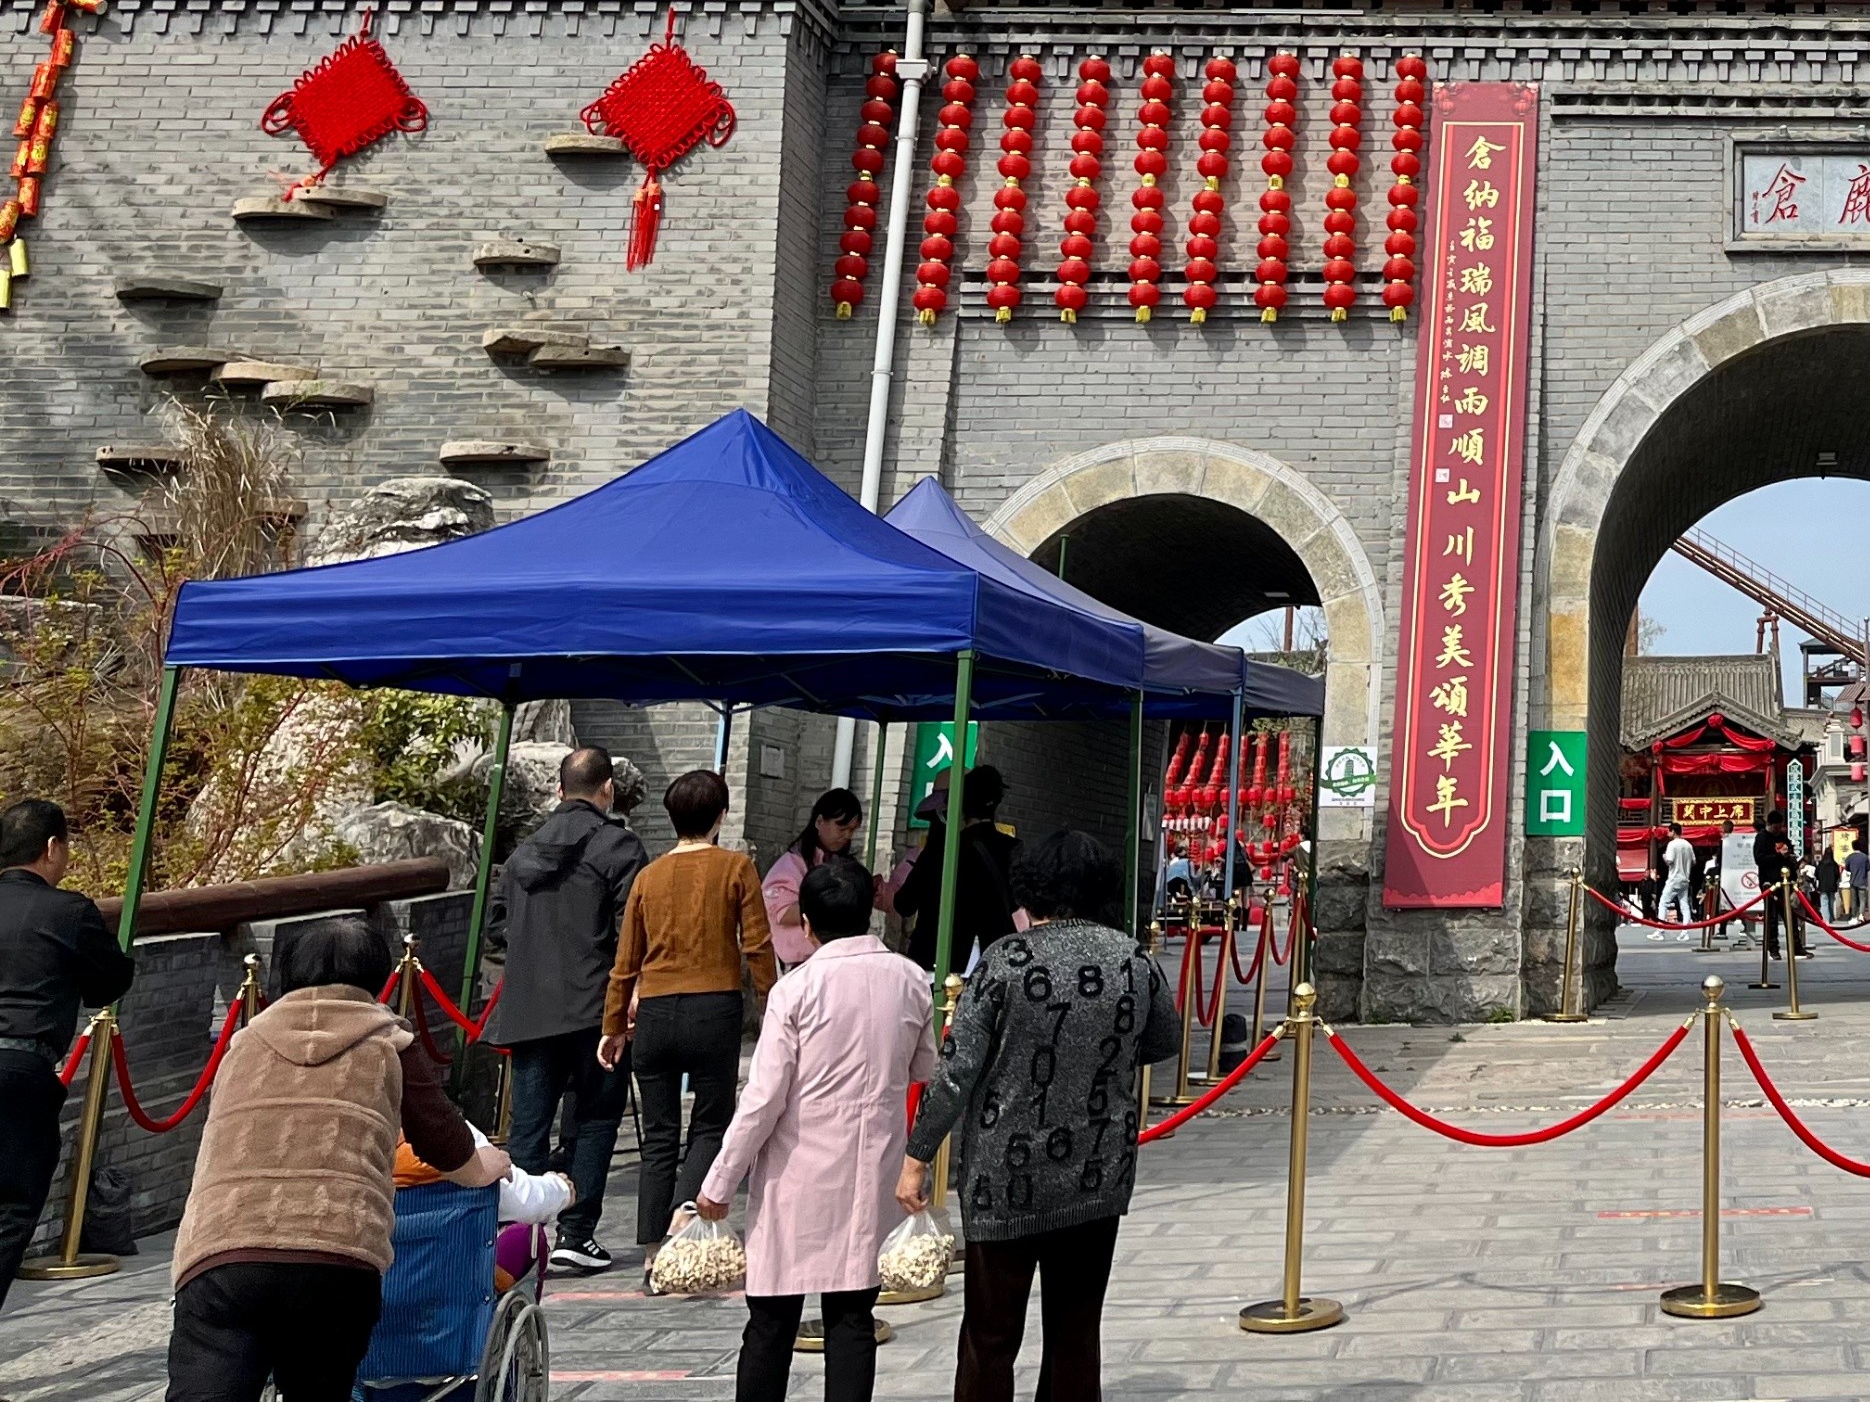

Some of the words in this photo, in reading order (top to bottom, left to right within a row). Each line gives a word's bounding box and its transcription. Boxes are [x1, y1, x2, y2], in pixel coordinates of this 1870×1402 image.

[1539, 741, 1575, 823] 入口
[1024, 965, 1051, 1002] 6
[1078, 964, 1104, 997] 8
[1120, 957, 1138, 994] 1
[1047, 1002, 1072, 1045] 7
[1114, 995, 1135, 1033] 8
